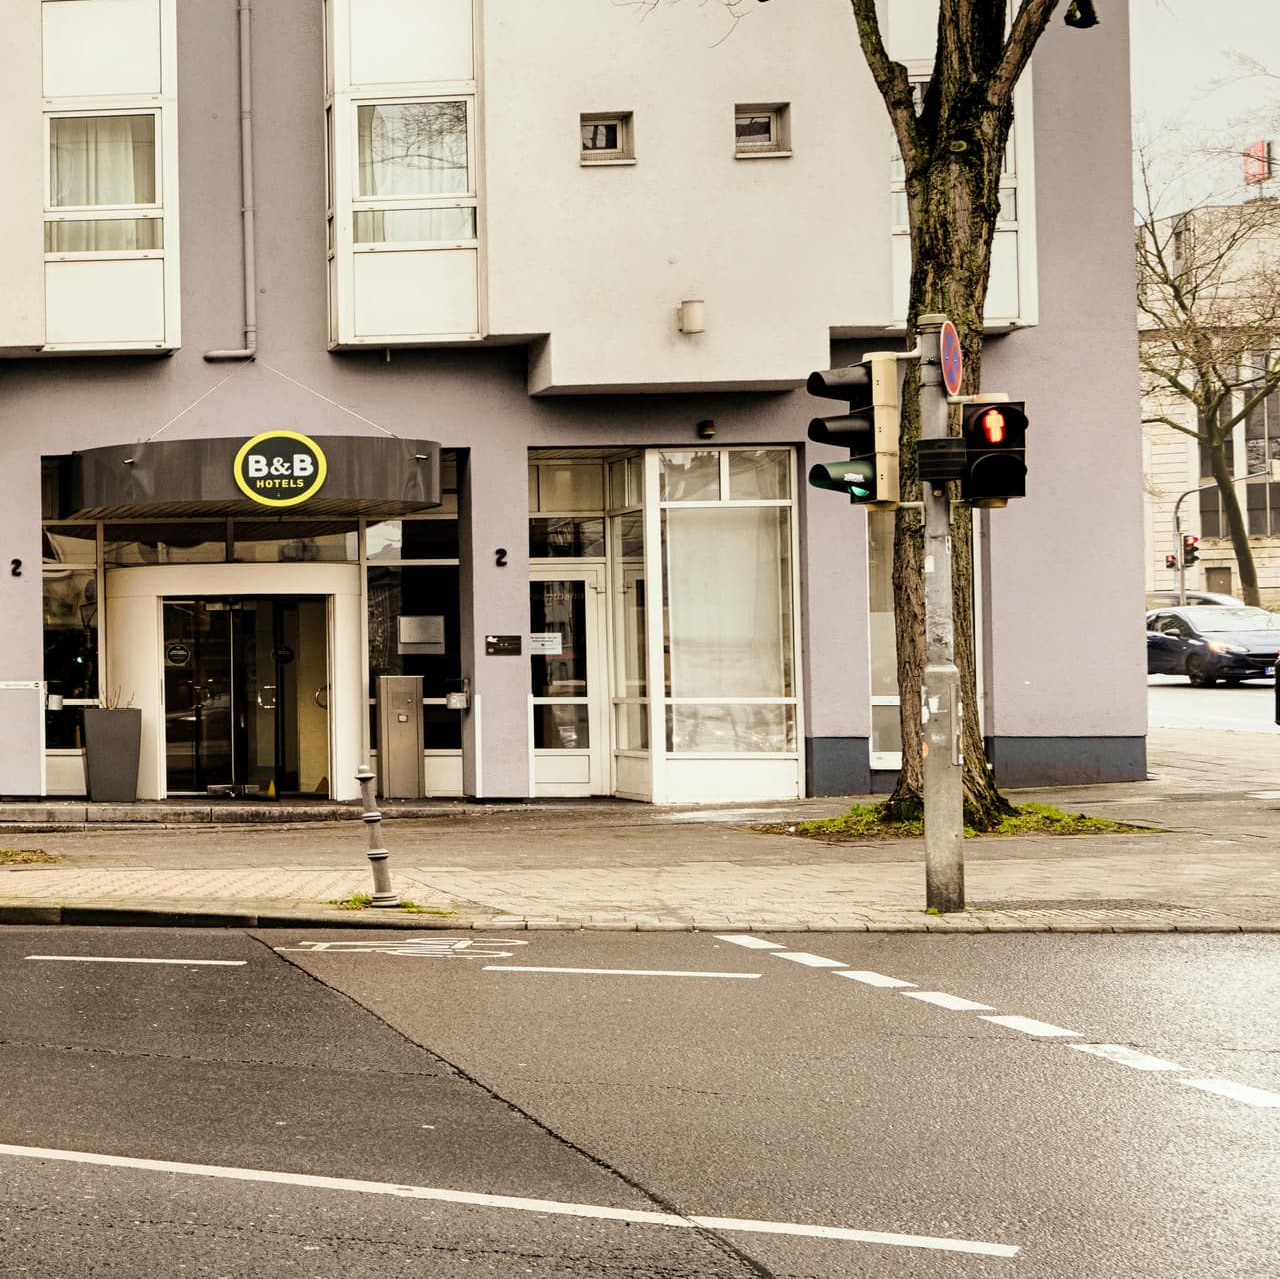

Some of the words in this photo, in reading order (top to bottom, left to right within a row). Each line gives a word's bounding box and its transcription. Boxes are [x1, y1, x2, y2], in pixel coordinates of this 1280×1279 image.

[248, 454, 314, 478] B&B
[256, 479, 304, 489] HOTELS
[495, 548, 508, 567] 2
[11, 558, 22, 577] 2
